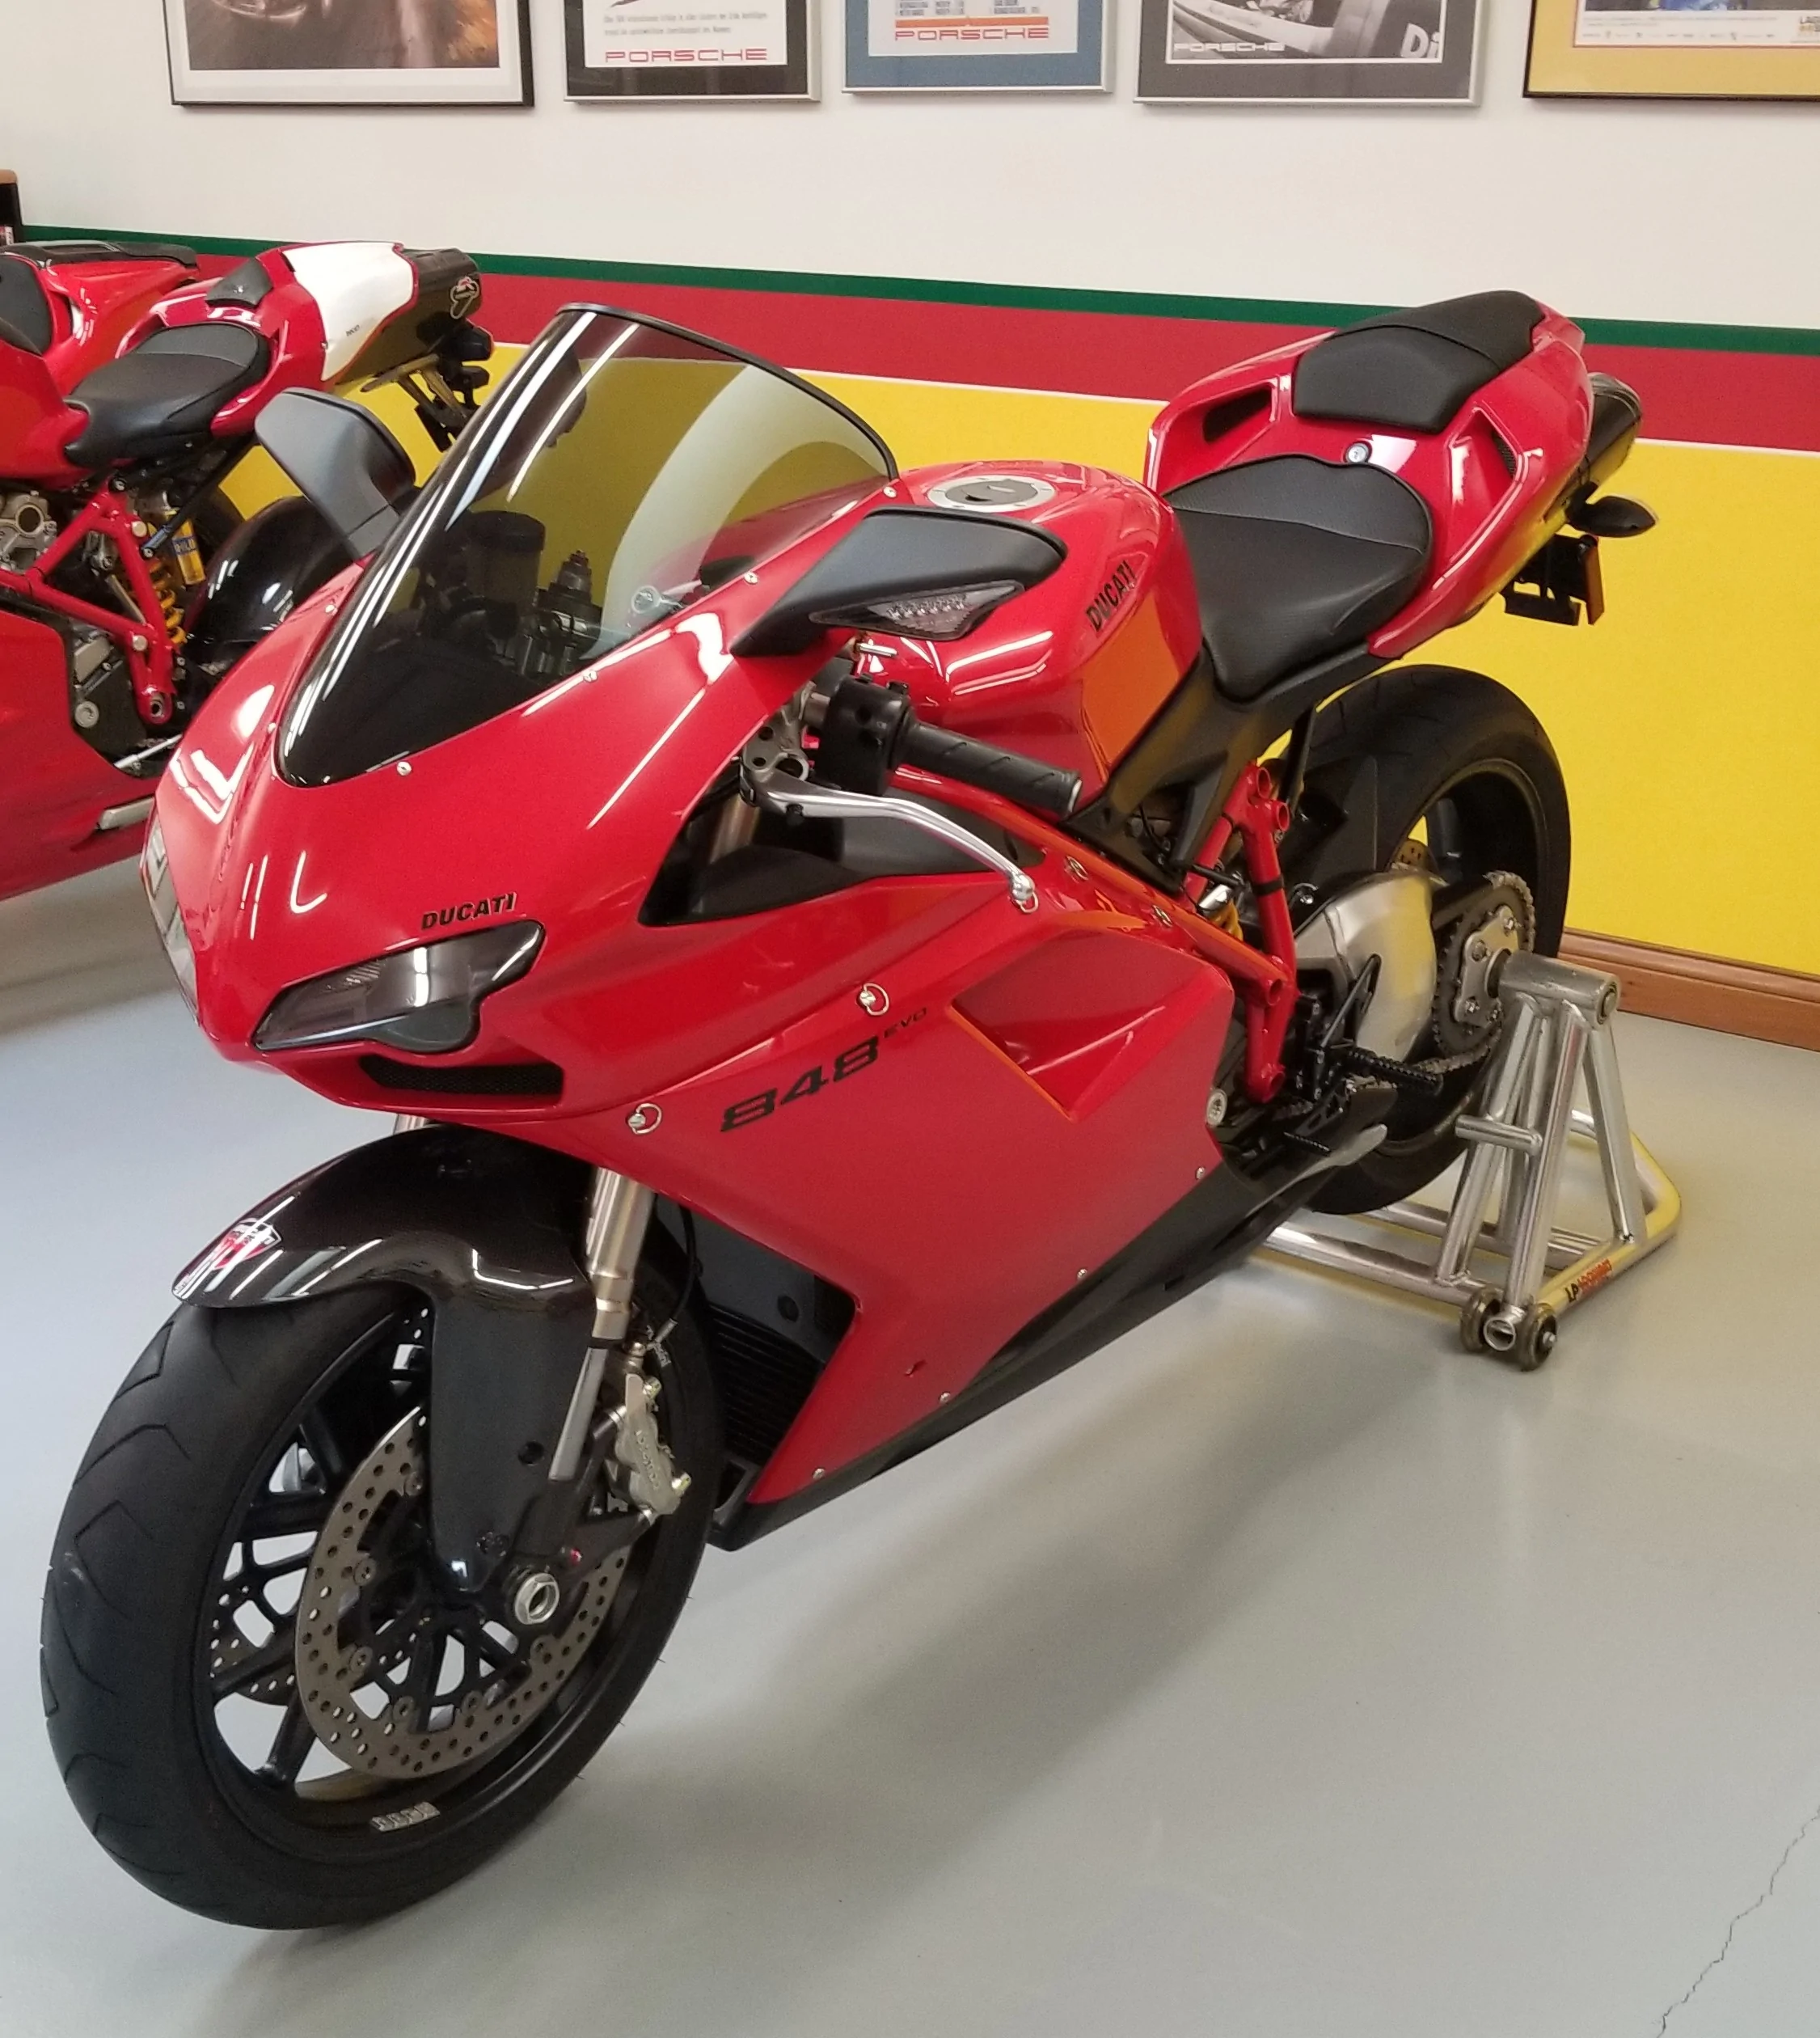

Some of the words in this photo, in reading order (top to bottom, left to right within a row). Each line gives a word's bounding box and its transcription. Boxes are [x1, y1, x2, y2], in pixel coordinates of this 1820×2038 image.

[895, 27, 1049, 40] PORSCHE
[606, 48, 767, 62] PORSCHE
[1086, 560, 1136, 632] DUCATI
[421, 892, 517, 930] DUCATI
[720, 1035, 879, 1132] 848
